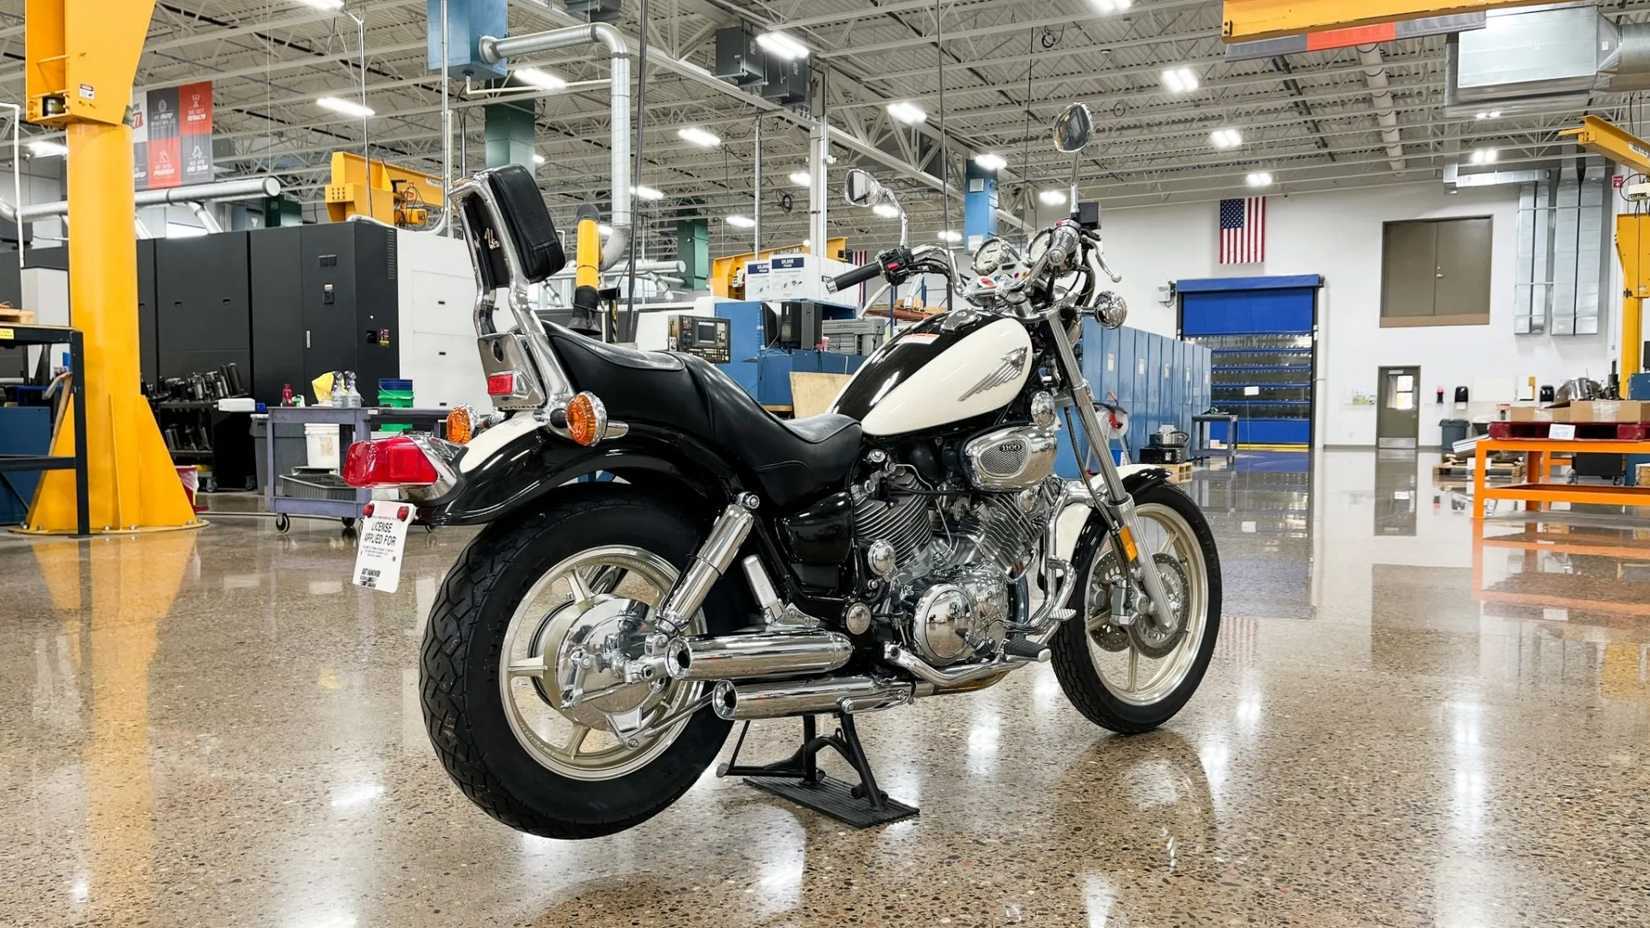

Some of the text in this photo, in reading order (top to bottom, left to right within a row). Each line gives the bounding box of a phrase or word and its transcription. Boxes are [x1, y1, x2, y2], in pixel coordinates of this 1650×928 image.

[371, 521, 393, 533] LICENSE
[364, 533, 397, 546] APPLIED FOR
